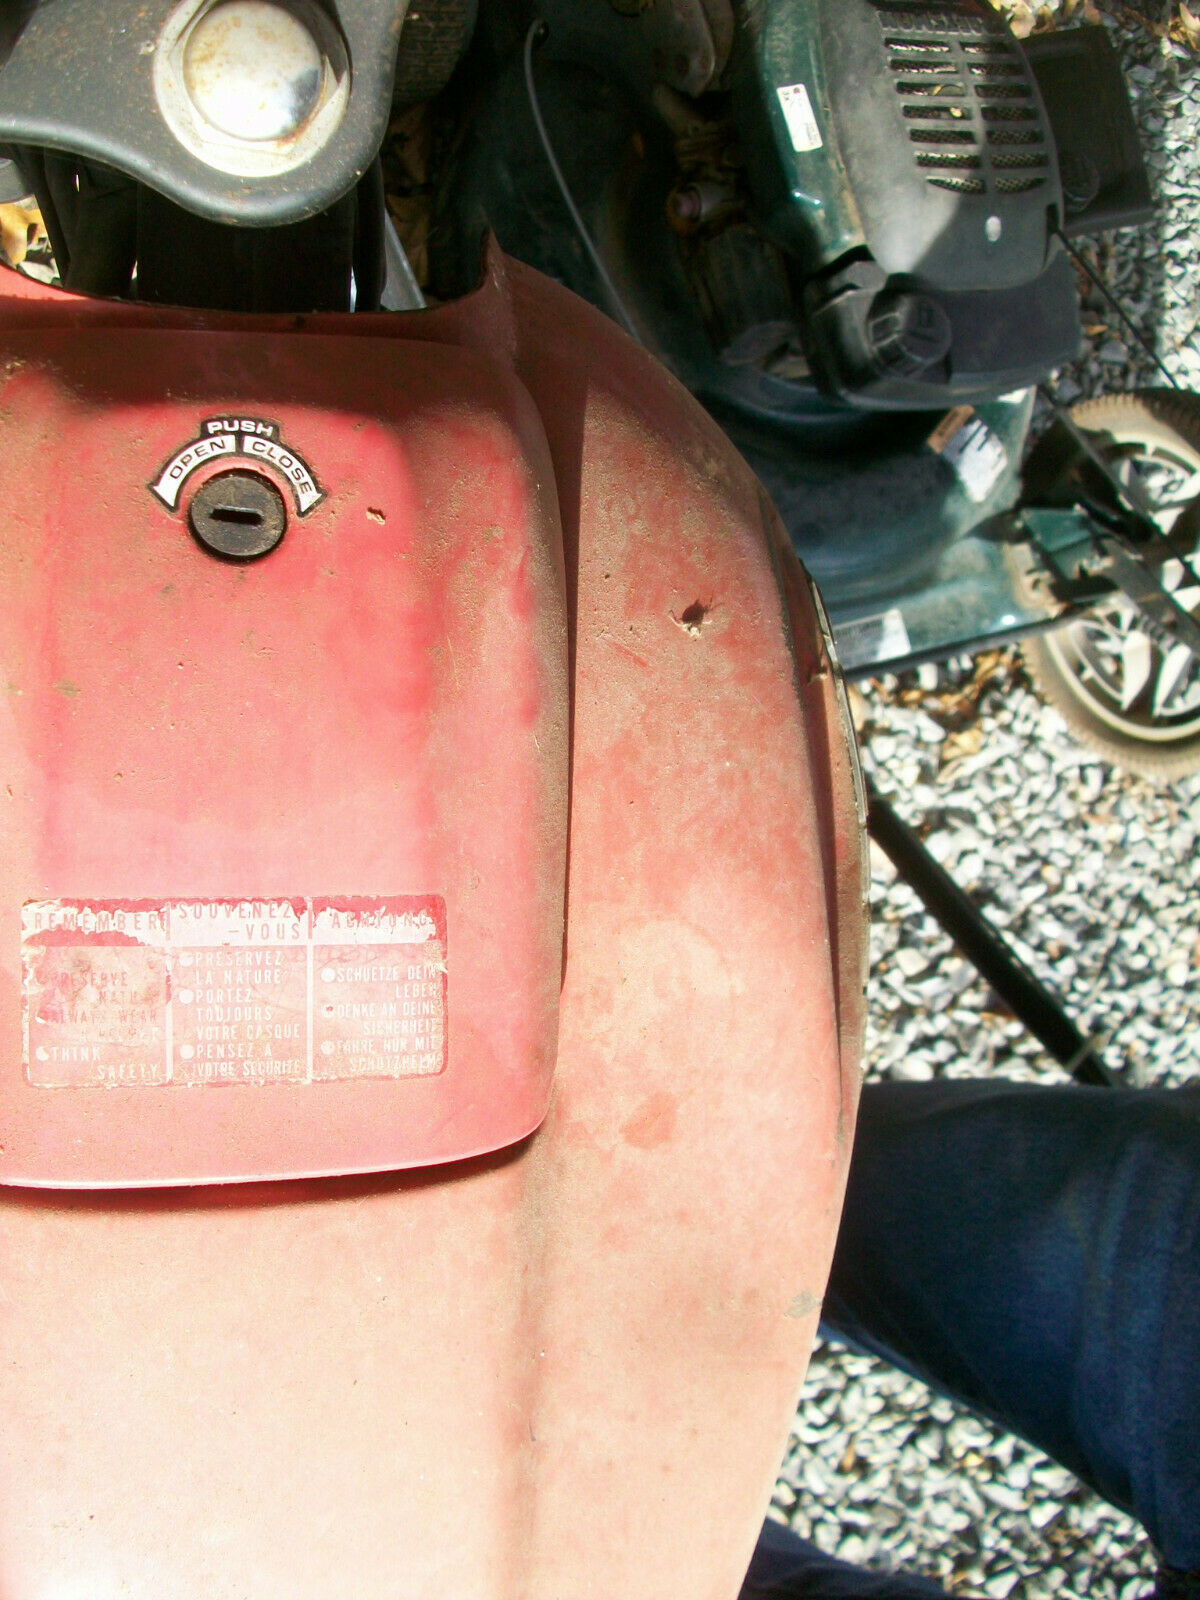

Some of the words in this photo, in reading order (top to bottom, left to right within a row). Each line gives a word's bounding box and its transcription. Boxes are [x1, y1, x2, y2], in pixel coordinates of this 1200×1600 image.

[207, 419, 273, 437] PUSH
[169, 438, 226, 480] OPEN
[252, 440, 312, 494] CLOSE
[178, 903, 292, 919] SOUVENEZ
[34, 912, 157, 931] REMEMBER
[195, 951, 282, 967] PRESERVEZ
[195, 969, 213, 985] LA
[224, 969, 281, 985] NATURE
[337, 966, 400, 982] SCHUETZE
[407, 964, 437, 980] DEIN
[195, 988, 252, 1004] PORTEZ
[395, 983, 437, 999] LEBEN
[197, 1006, 272, 1022] TOUJOURS
[337, 1004, 376, 1018] DENKE
[402, 1001, 436, 1016] DEINE
[196, 1024, 238, 1040] VOTRE
[247, 1023, 300, 1039] CASQUE
[196, 1043, 254, 1059] PENSEZ
[383, 1038, 409, 1053] NUR
[415, 1036, 437, 1051] MIT
[52, 1046, 101, 1062] THINK
